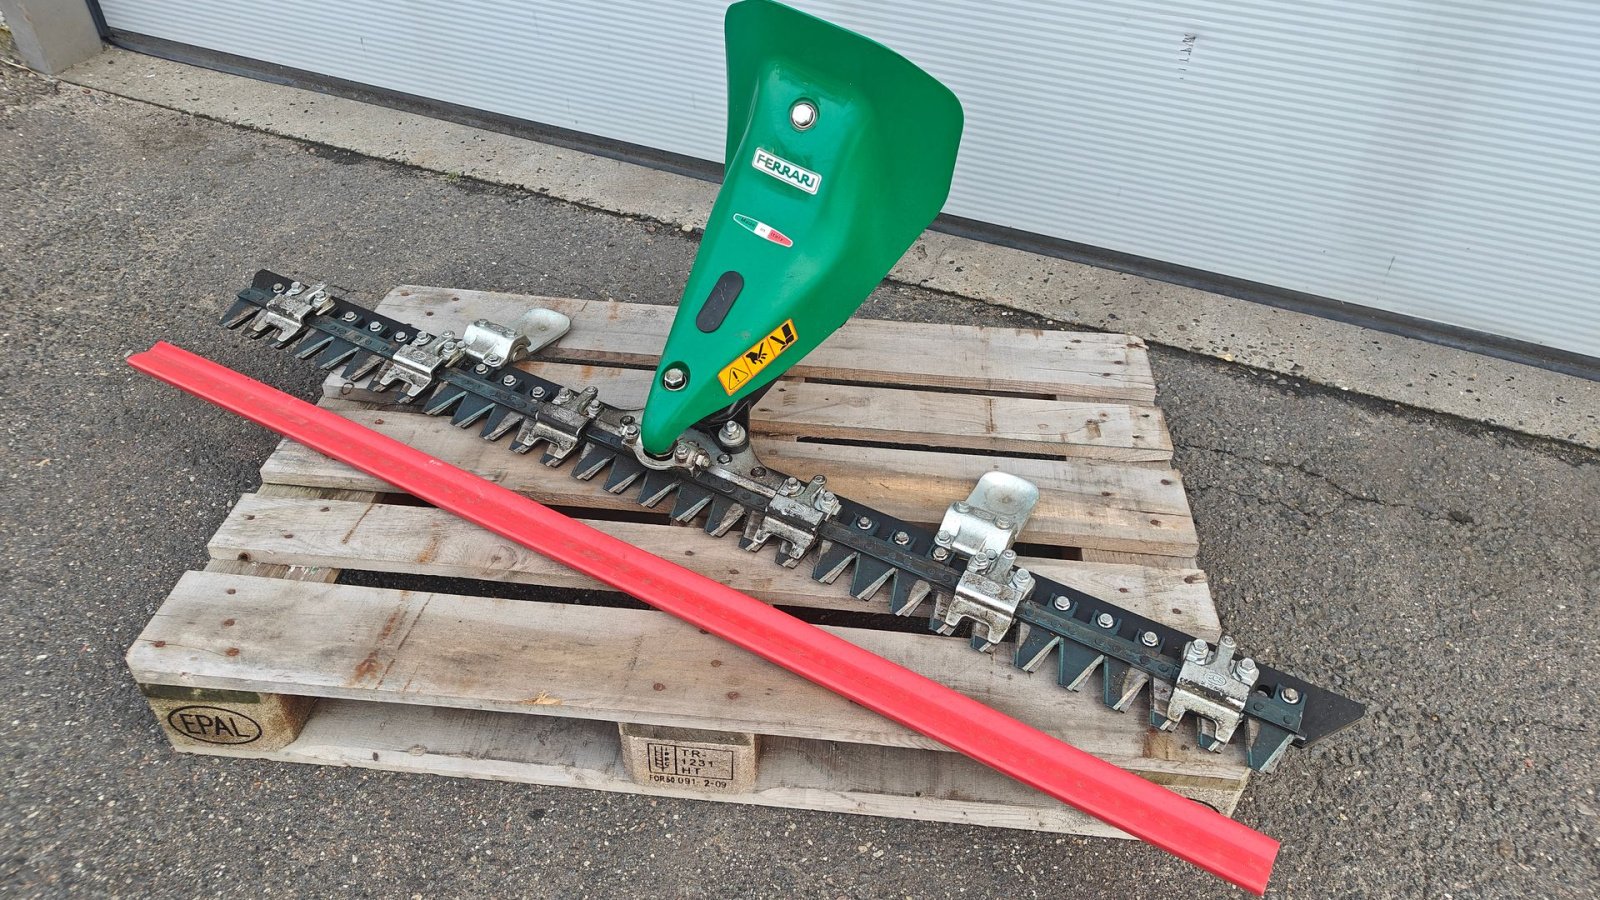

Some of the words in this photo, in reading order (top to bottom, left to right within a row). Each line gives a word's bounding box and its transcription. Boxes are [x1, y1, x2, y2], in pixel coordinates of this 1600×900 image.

[756, 153, 815, 188] FERRARI
[179, 713, 251, 738] EPAL
[681, 758, 714, 768] 1231
[681, 767, 701, 776] HT
